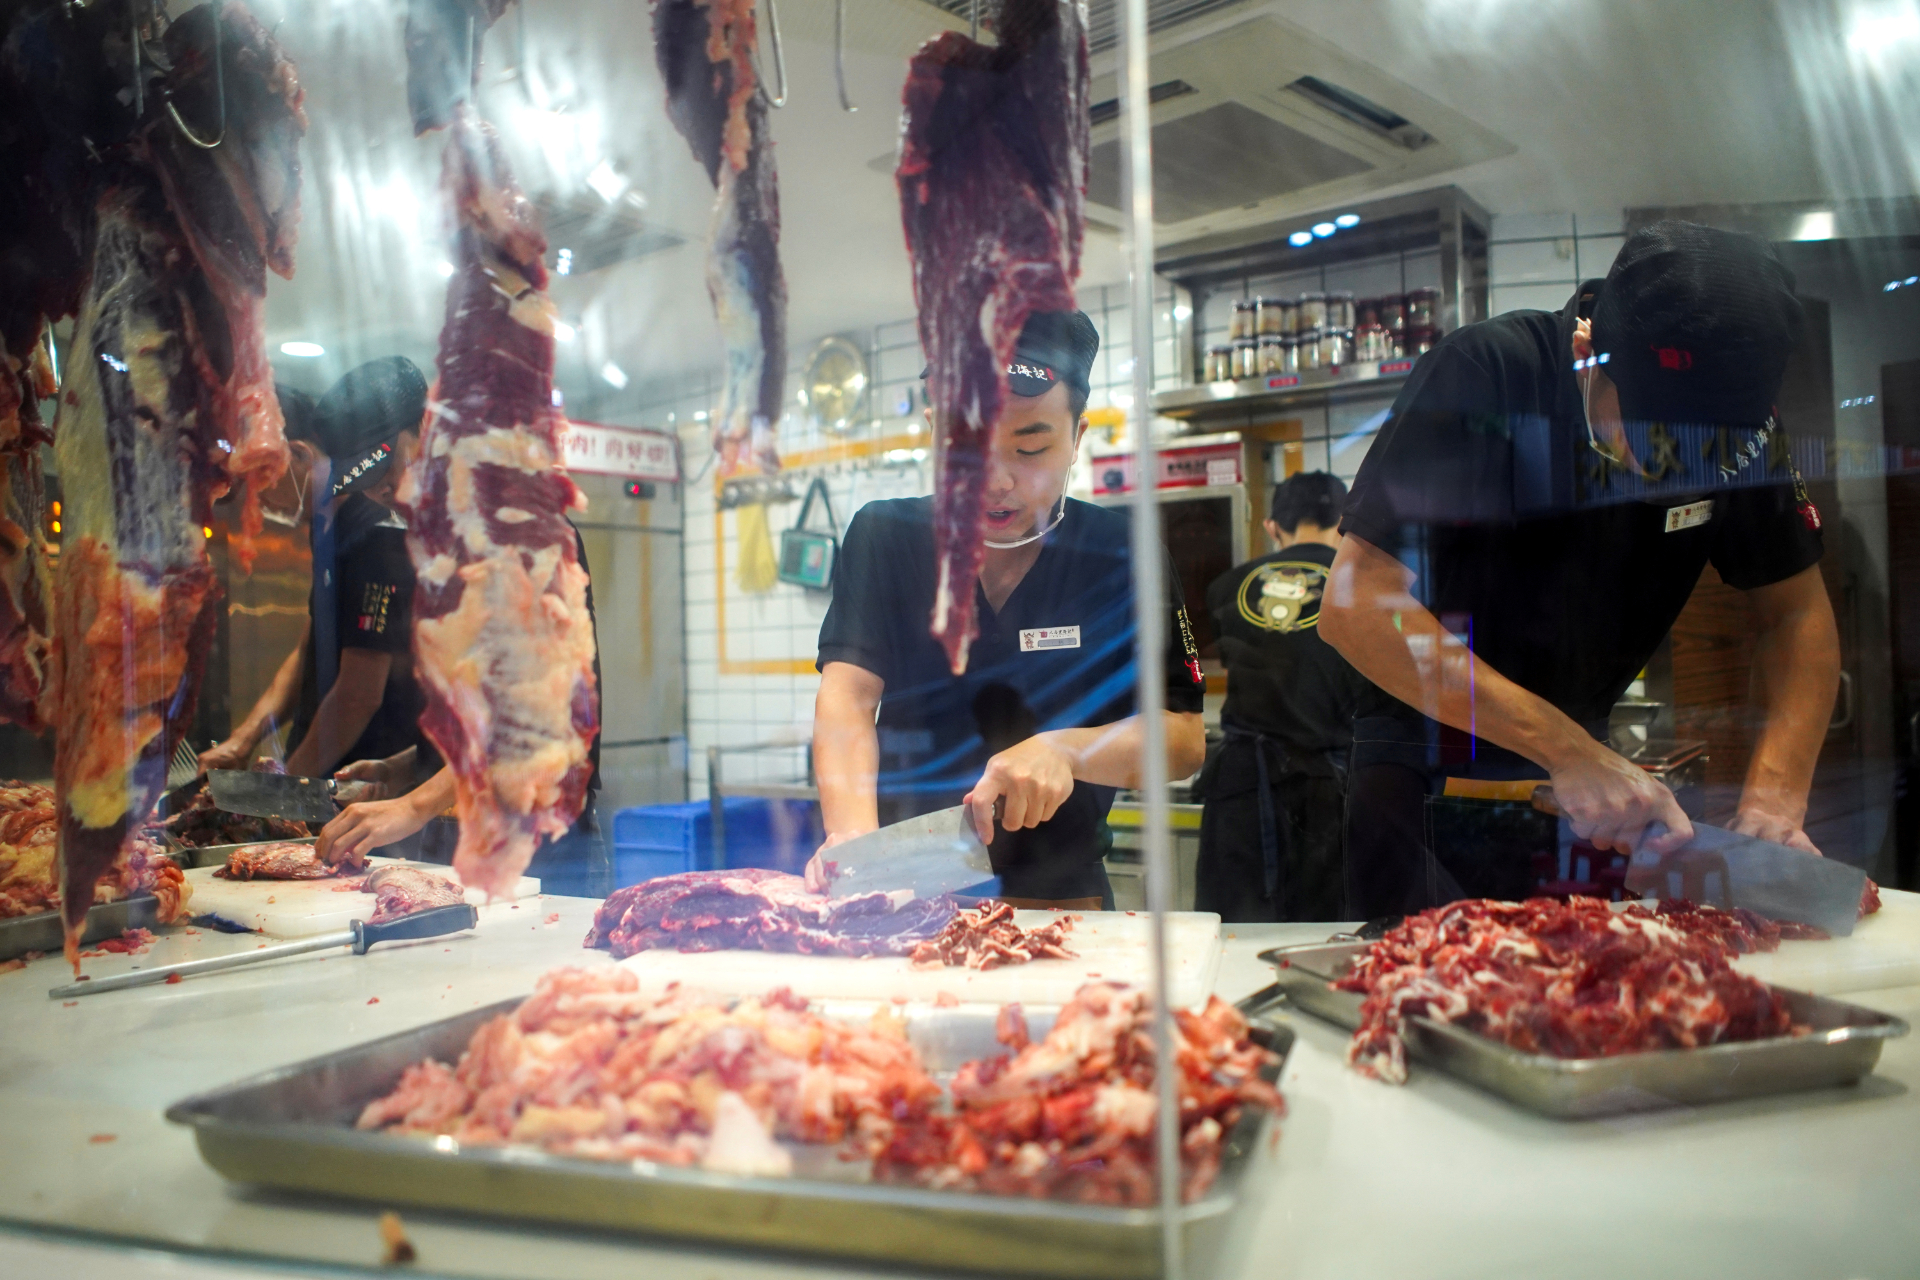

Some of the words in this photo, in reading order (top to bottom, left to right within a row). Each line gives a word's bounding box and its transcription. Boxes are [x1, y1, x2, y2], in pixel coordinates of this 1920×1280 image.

[332, 449, 387, 496] 八合里海记
